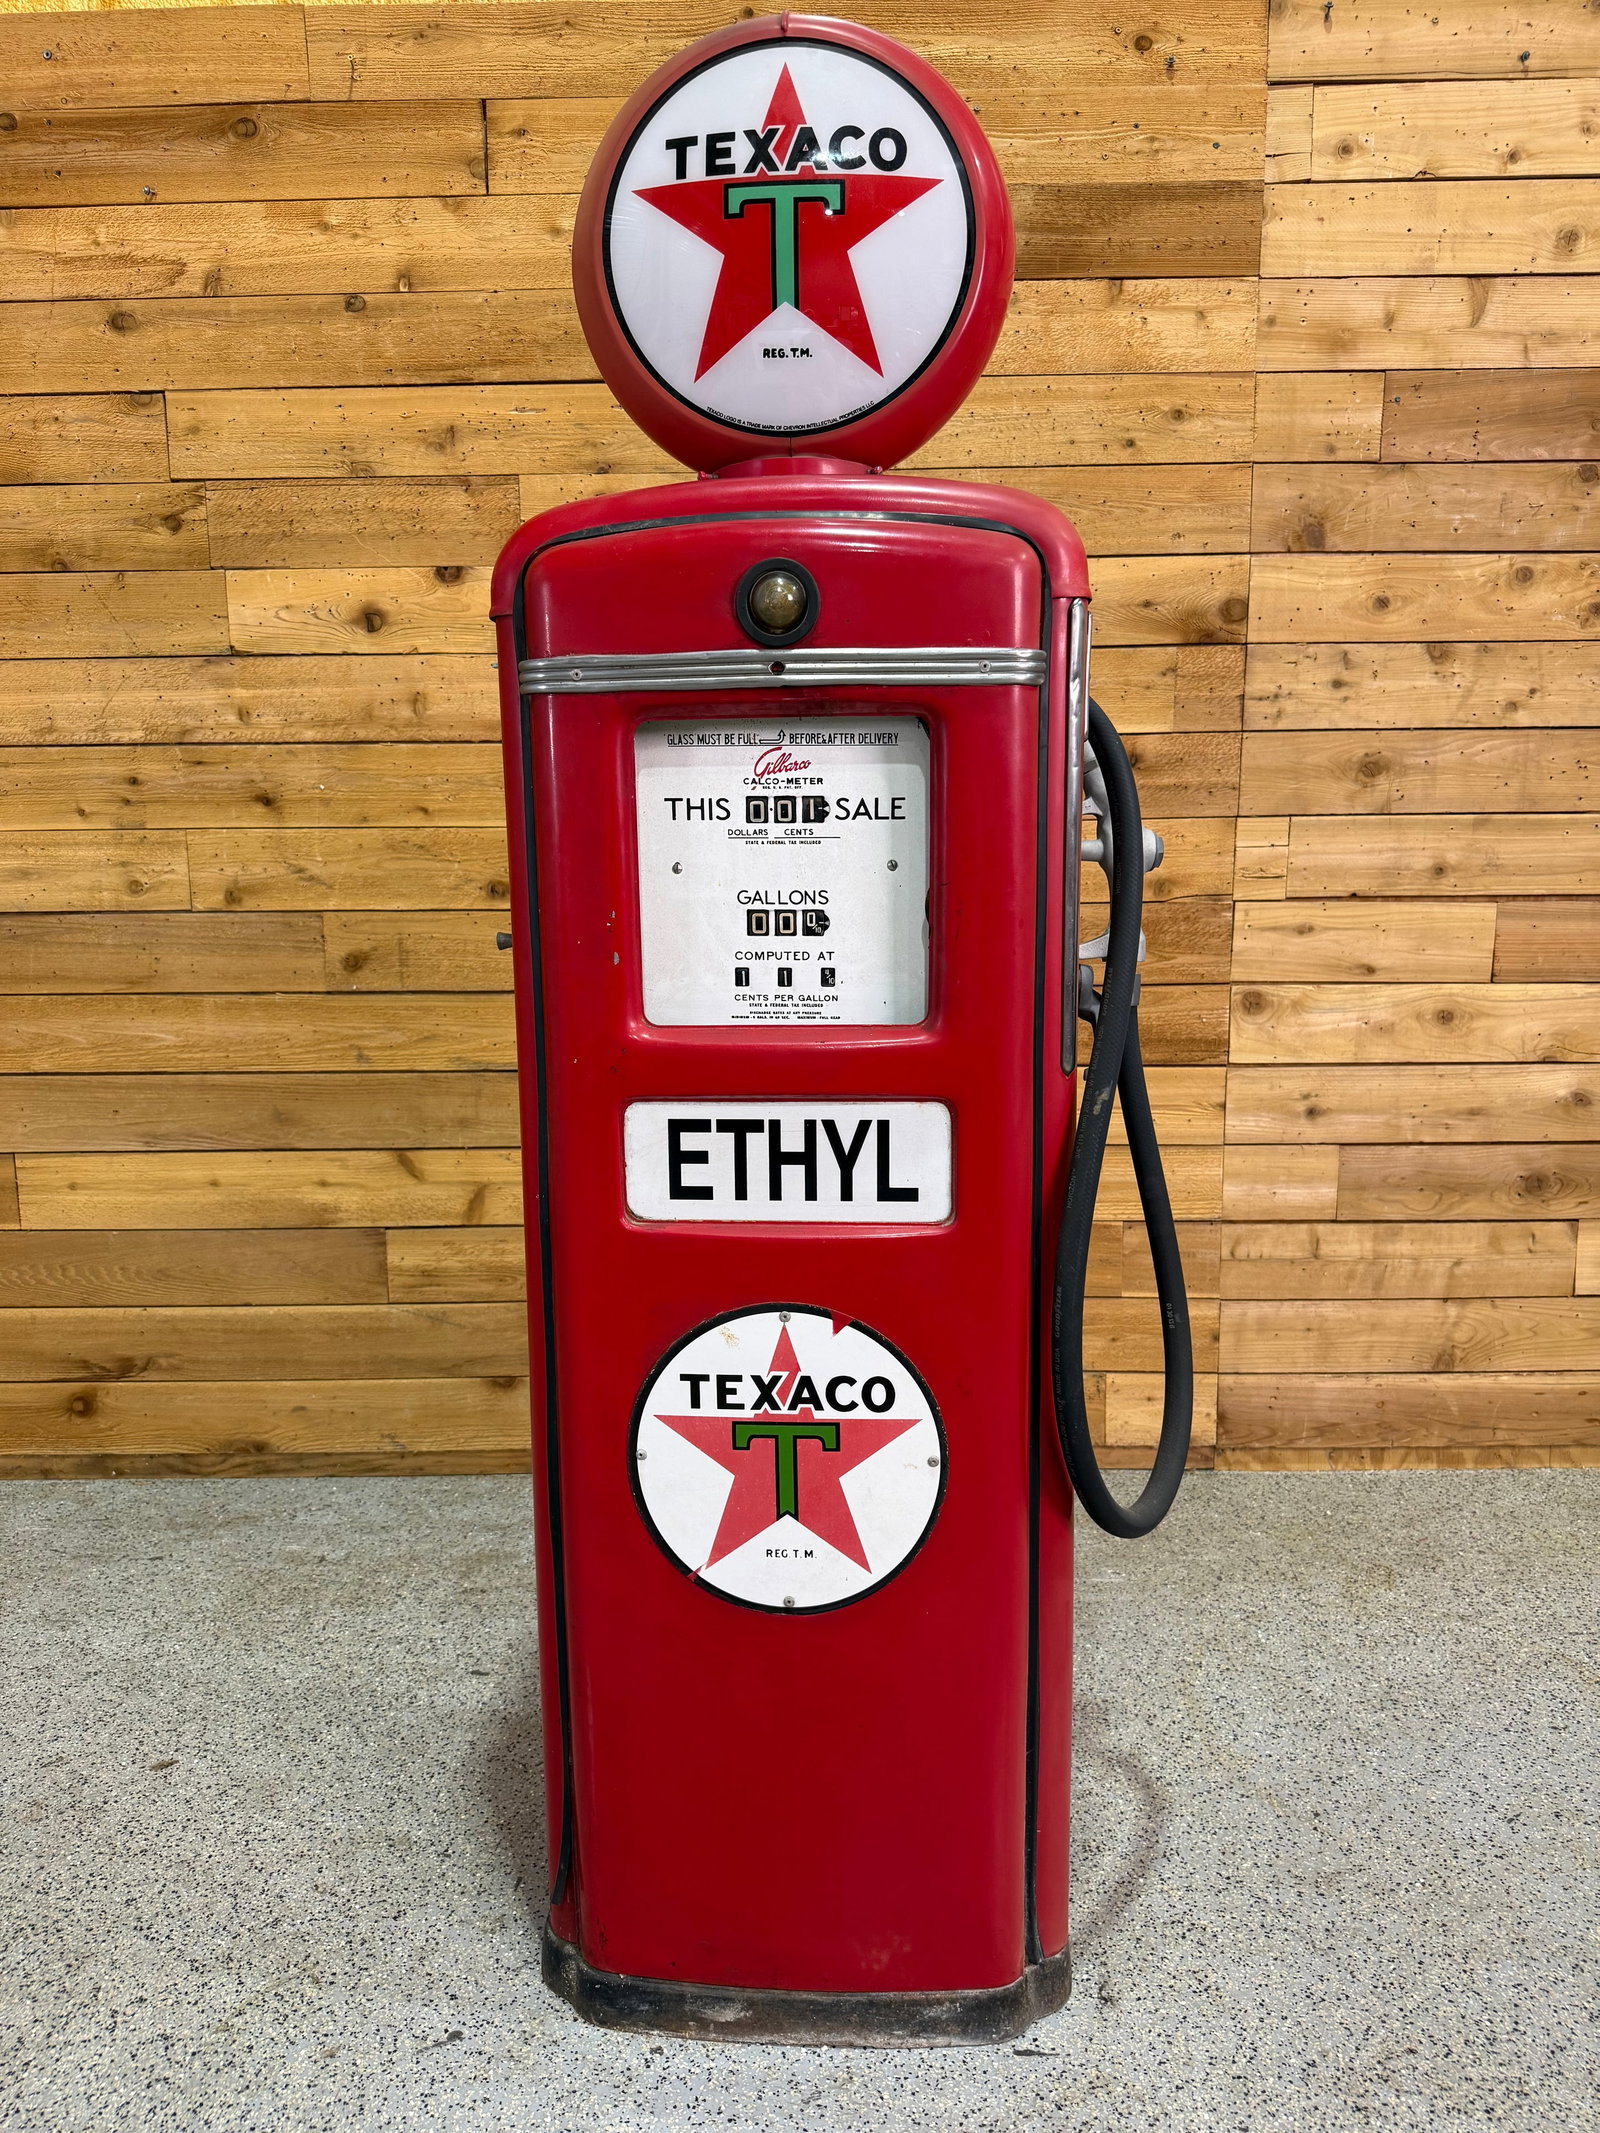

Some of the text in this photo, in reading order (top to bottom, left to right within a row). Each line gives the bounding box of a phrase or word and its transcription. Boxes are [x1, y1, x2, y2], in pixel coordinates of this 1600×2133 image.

[665, 124, 909, 180] TEXACO
[723, 178, 846, 311] T
[762, 347, 789, 359] REG.
[746, 421, 761, 429] TRADE
[667, 733, 694, 746] GLASS
[697, 733, 722, 745] MUST
[724, 733, 736, 745] BE
[737, 733, 757, 745] FULL
[858, 732, 899, 744] DELIVERY
[752, 746, 812, 781] Gilbarco
[742, 777, 824, 786] CALCO-METER
[663, 797, 731, 821] THIS
[834, 796, 906, 821] SALE
[727, 828, 814, 836] DOLLARS CENTS
[736, 889, 829, 905] GALLONS
[734, 950, 835, 961] COMPUTED AT
[734, 994, 839, 1002] CENTS PER GALLON
[1101, 967, 1113, 1016] GOODYEAR
[667, 1118, 919, 1202] ETHYL
[1054, 1285, 1063, 1338] GOODYEAR
[679, 1372, 896, 1414] TEXACO
[732, 1421, 840, 1521] T
